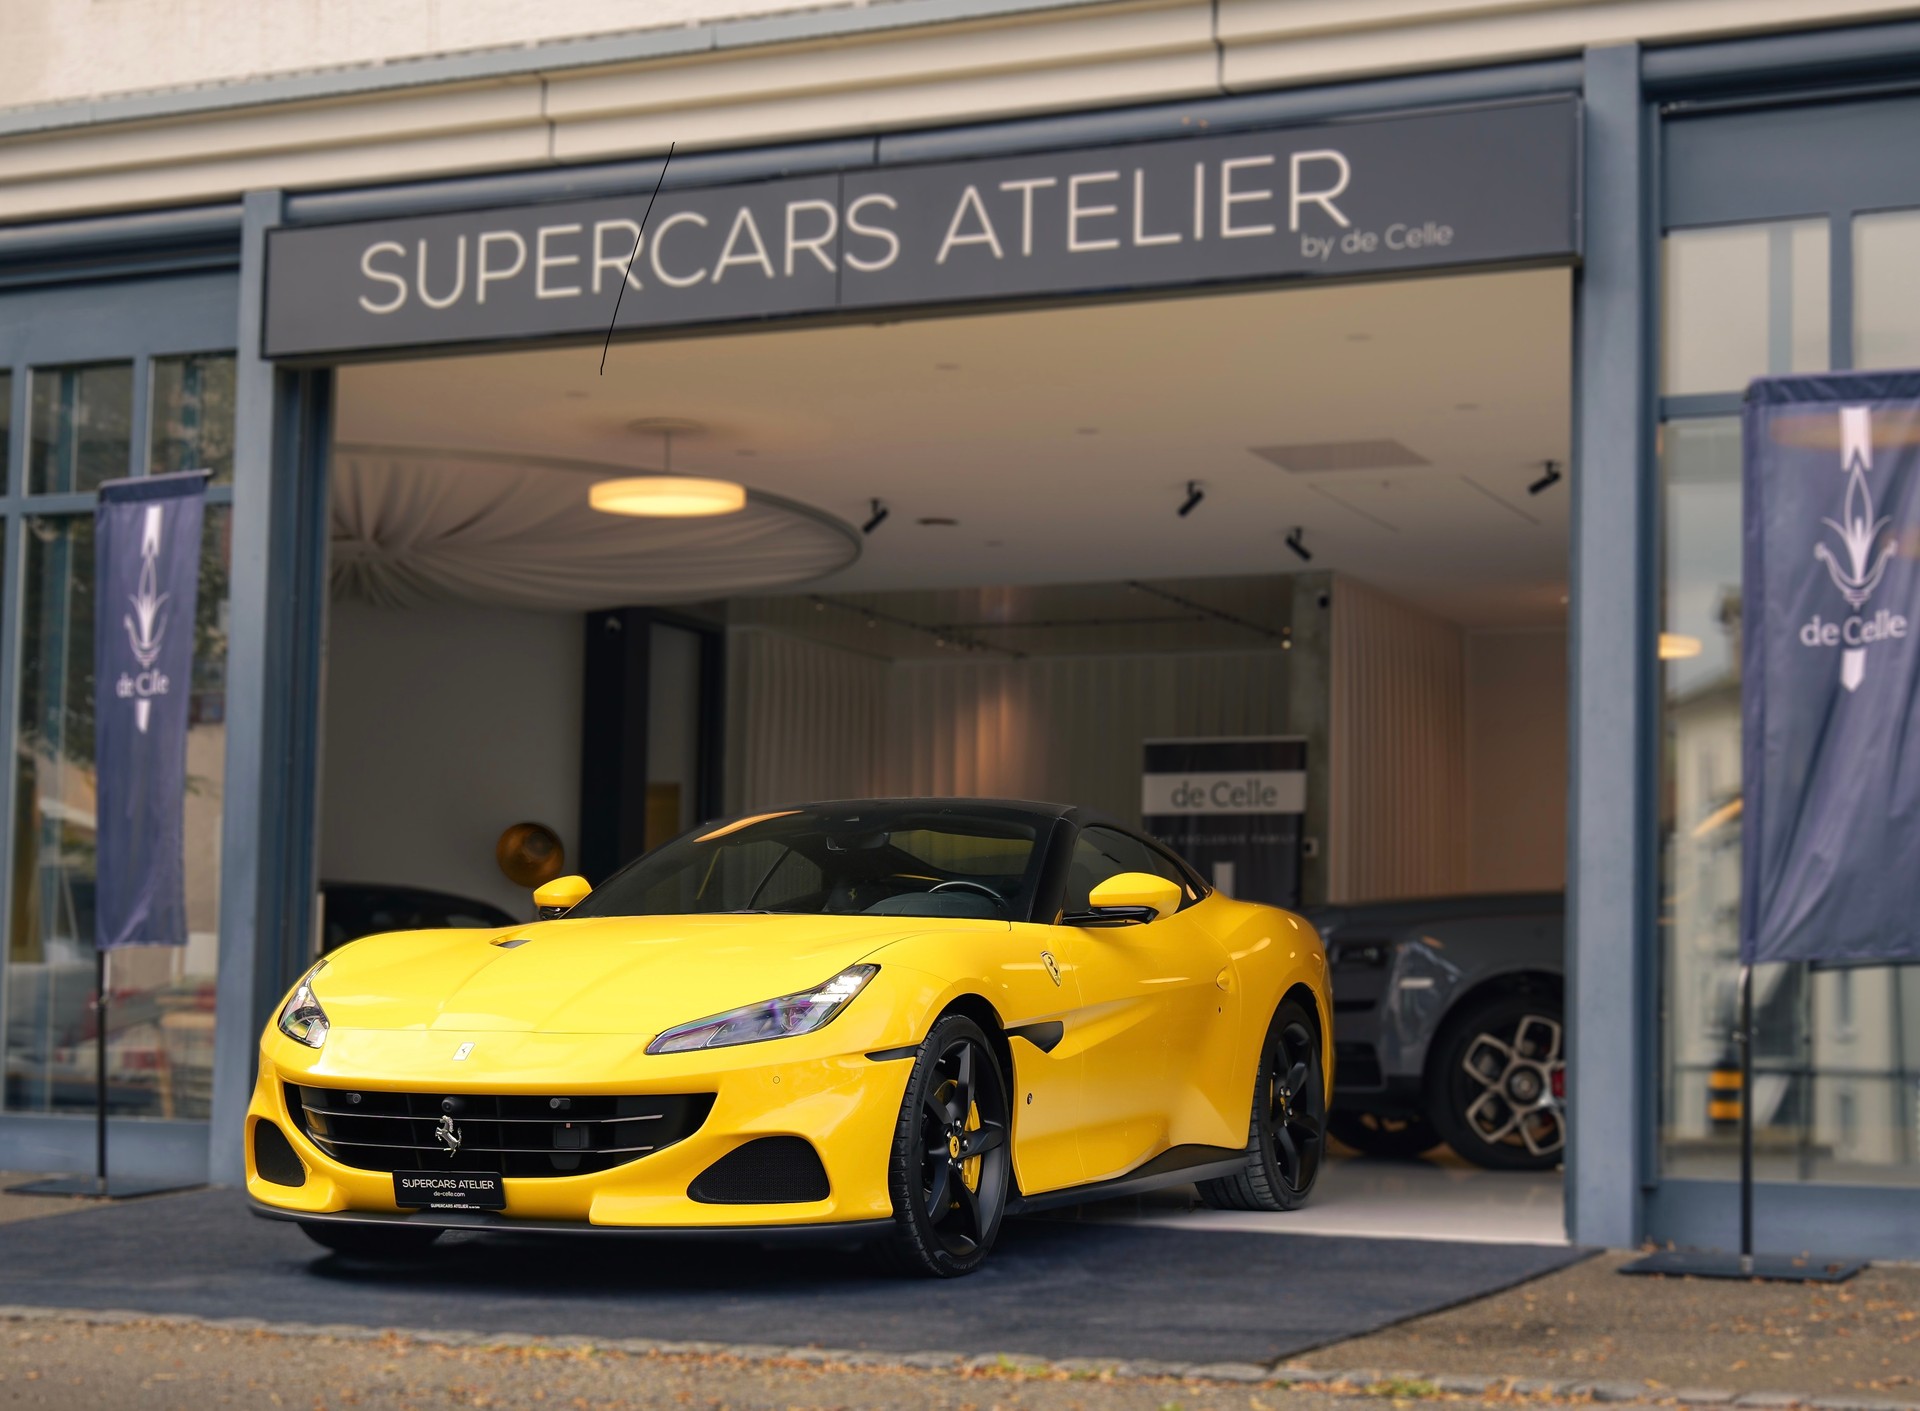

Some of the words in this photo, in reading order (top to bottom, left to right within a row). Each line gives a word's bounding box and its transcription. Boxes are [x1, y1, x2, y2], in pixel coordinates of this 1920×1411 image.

[359, 193, 900, 315] SUPERCARS
[935, 149, 1351, 265] ATELIER
[1301, 232, 1335, 263] by
[1341, 227, 1379, 255] de
[1384, 220, 1454, 251] Celle
[1799, 614, 1840, 646] de
[1842, 609, 1908, 646] Celle
[1170, 780, 1205, 809] de
[1209, 778, 1278, 808] Celle
[402, 1178, 457, 1189] SUPERCARS
[458, 1179, 495, 1190] ATELIER
